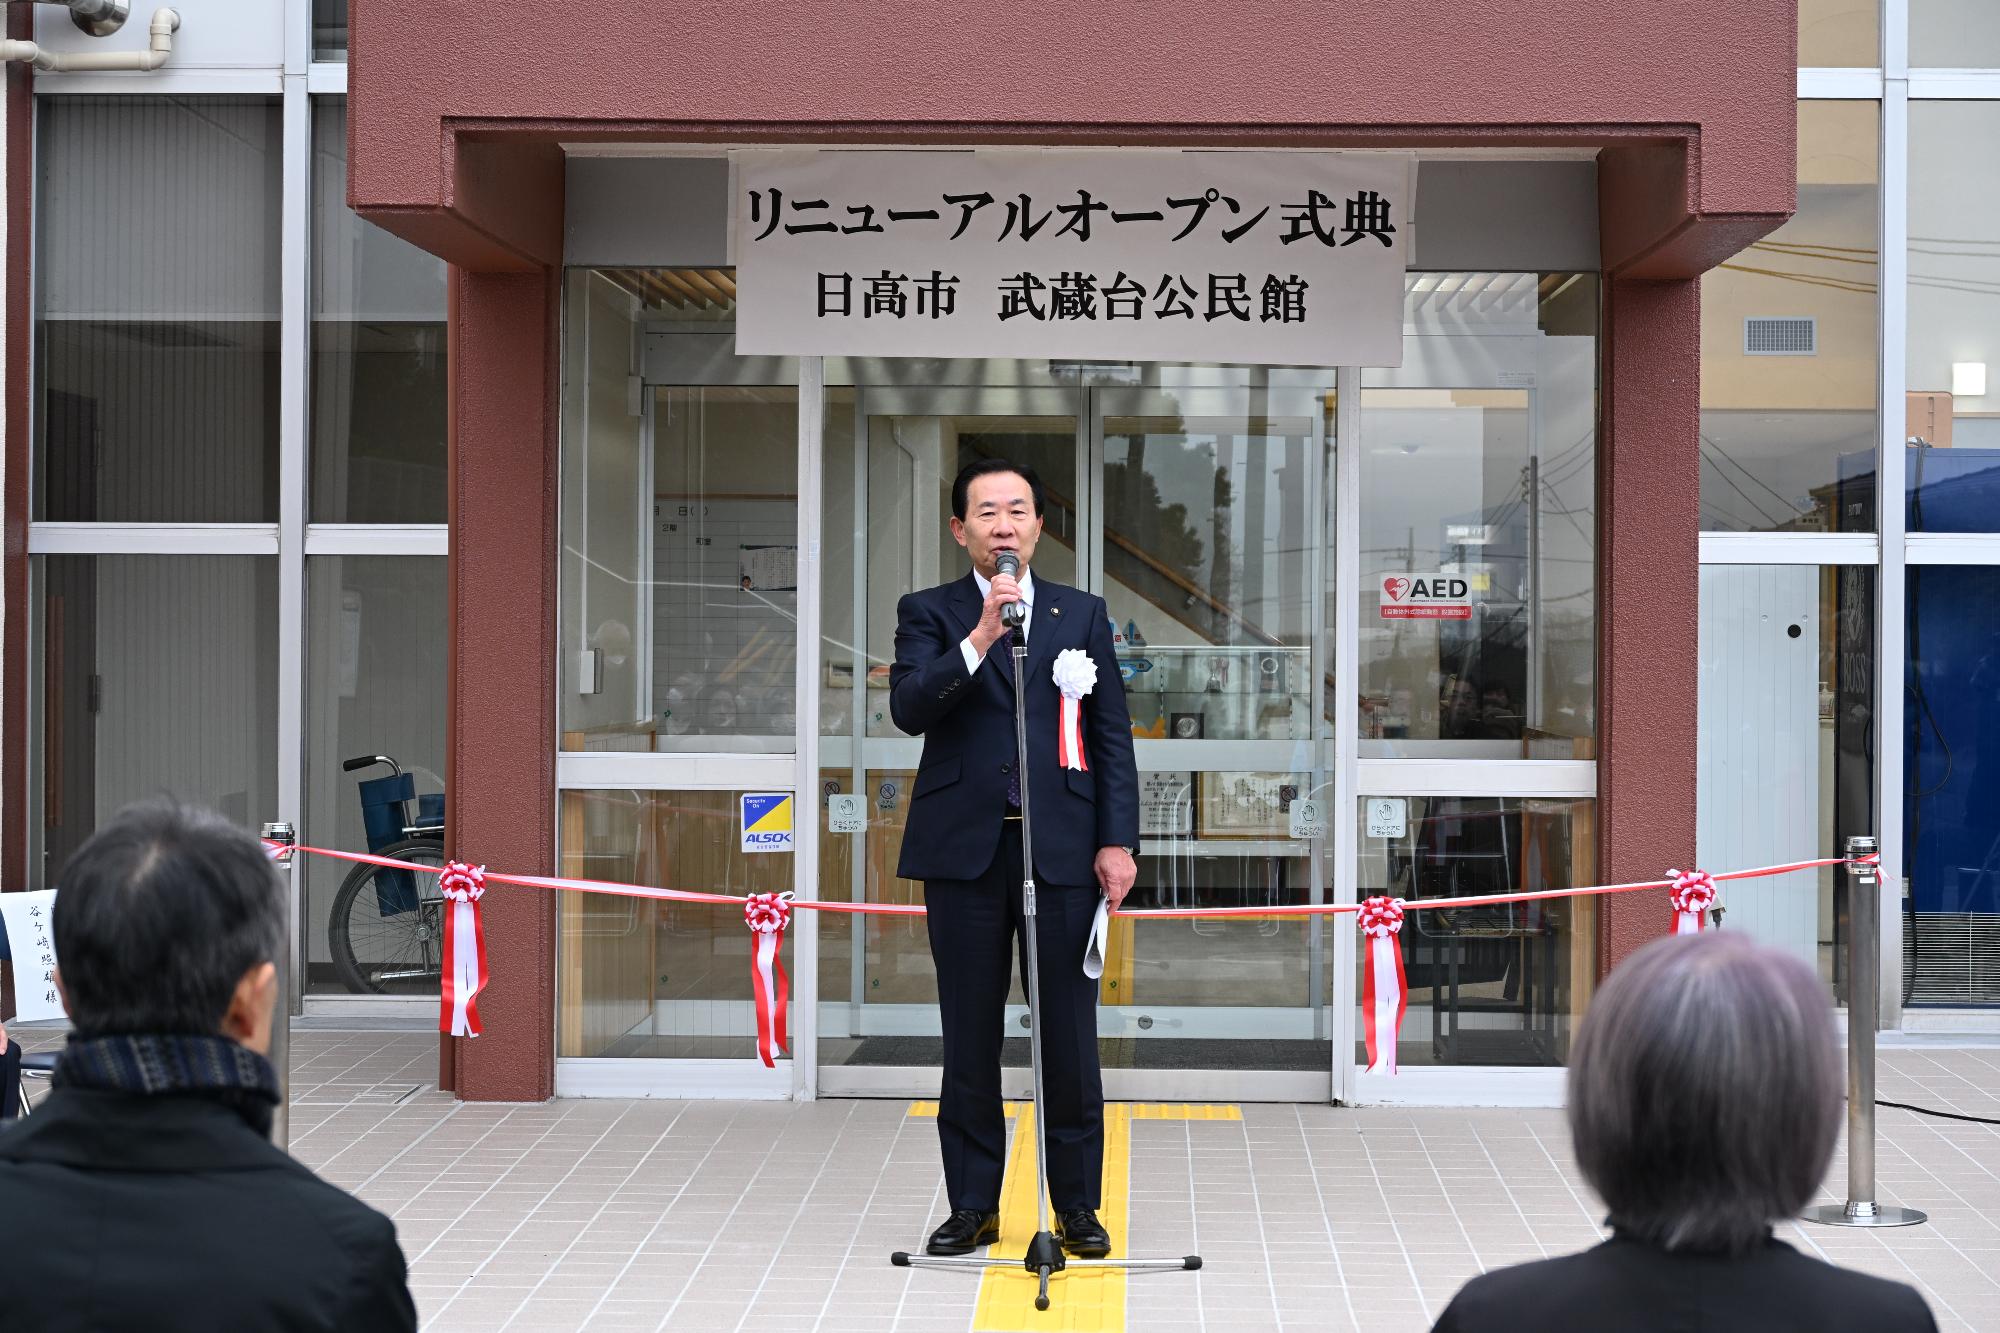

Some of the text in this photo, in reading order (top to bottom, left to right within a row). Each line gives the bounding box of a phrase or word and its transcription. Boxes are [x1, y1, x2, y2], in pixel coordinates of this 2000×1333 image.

[747, 187, 1397, 248] リニューアルオープン式典
[816, 269, 1309, 324] 日高市 武蔵台公民館
[1409, 578, 1468, 598] AED
[1842, 651, 1867, 695] BOSS
[745, 833, 791, 843] ALSOK
